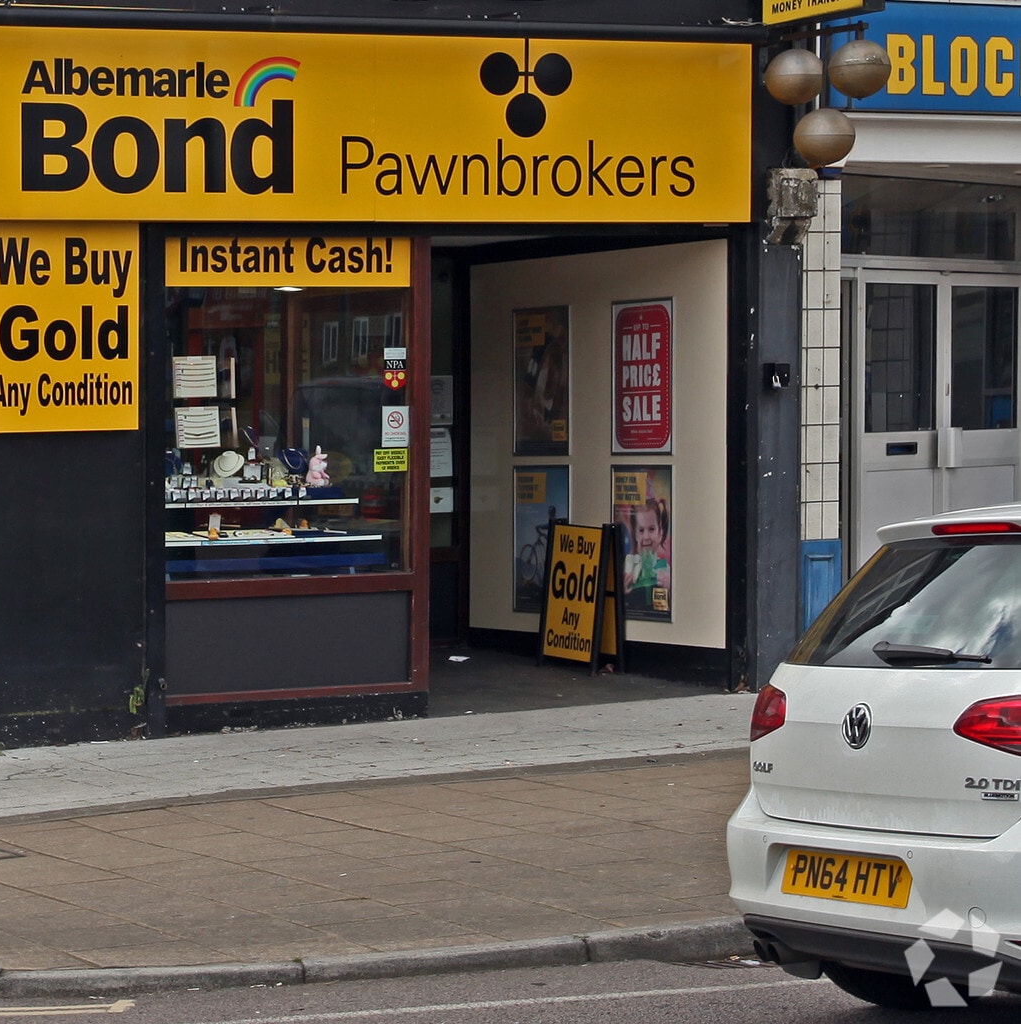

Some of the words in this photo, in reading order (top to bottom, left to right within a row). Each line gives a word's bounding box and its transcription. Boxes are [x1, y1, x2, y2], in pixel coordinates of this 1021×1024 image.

[21, 58, 230, 99] Albemarle
[886, 33, 1021, 97] BLOC
[21, 99, 294, 195] Bond
[341, 136, 695, 197] Pawnbrokers
[65, 237, 132, 298] Buy
[180, 237, 294, 273] Instant
[306, 237, 393, 273] Cash!
[0, 305, 129, 361] Gold
[622, 332, 661, 361] HALF
[386, 360, 405, 369] NPA
[38, 373, 133, 407] Condition
[622, 395, 661, 422] SALE
[560, 534, 574, 553] We
[577, 536, 595, 559] Buy
[552, 560, 597, 603] Gold
[562, 607, 580, 630] Any
[547, 629, 591, 653] Condition
[992, 778, 1021, 791] TDI
[792, 854, 850, 892] PN64
[853, 861, 903, 899] HTV
